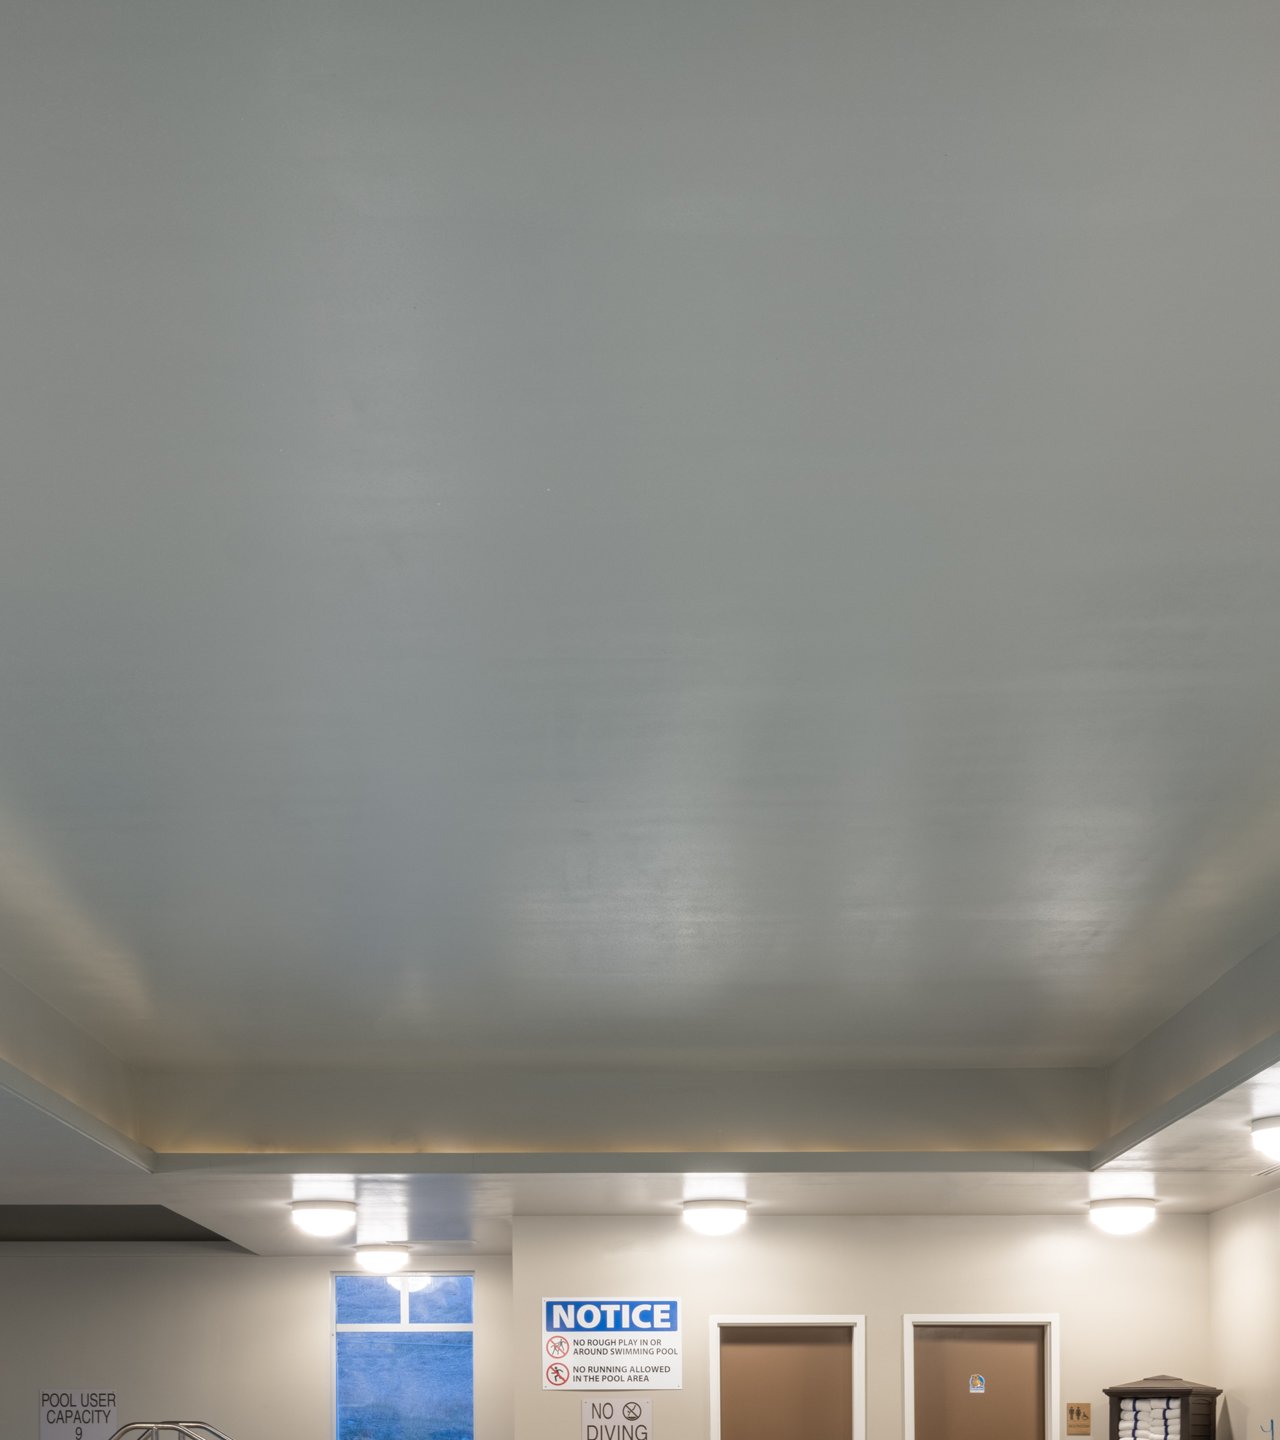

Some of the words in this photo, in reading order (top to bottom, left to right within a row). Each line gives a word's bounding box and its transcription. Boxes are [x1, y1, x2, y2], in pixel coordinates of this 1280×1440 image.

[552, 1304, 670, 1329] NOTICE
[42, 1393, 77, 1407] POOL
[81, 1393, 116, 1407] USER
[46, 1409, 111, 1424] CAPACITY
[591, 1402, 613, 1420] NO
[75, 1426, 83, 1440] 9
